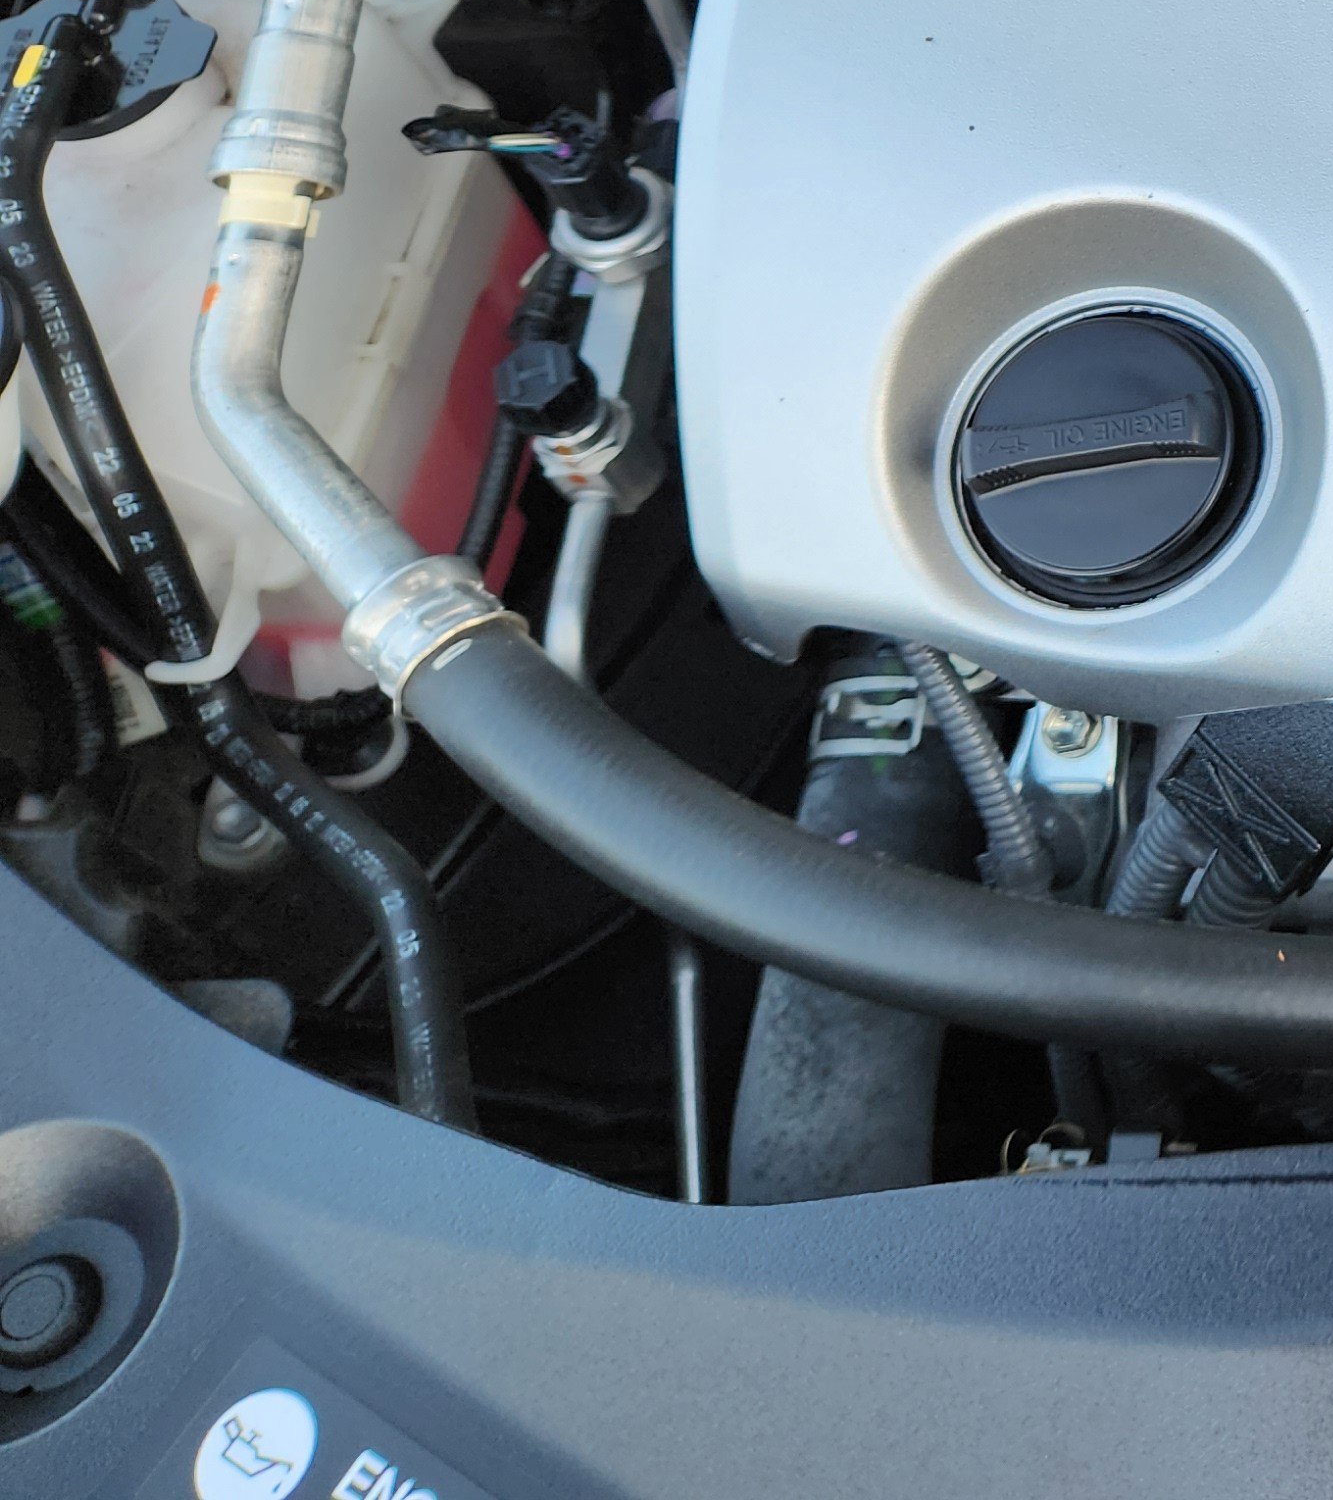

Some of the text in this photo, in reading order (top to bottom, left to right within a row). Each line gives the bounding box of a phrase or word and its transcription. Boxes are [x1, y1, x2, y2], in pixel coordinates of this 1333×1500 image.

[7, 241, 36, 269] 23
[30, 279, 70, 348] WATER
[93, 446, 121, 478] 22
[112, 491, 140, 520] 05
[1042, 408, 1187, 449] ENGINE OIL
[397, 928, 420, 958] 05
[330, 1448, 438, 1500] EN
